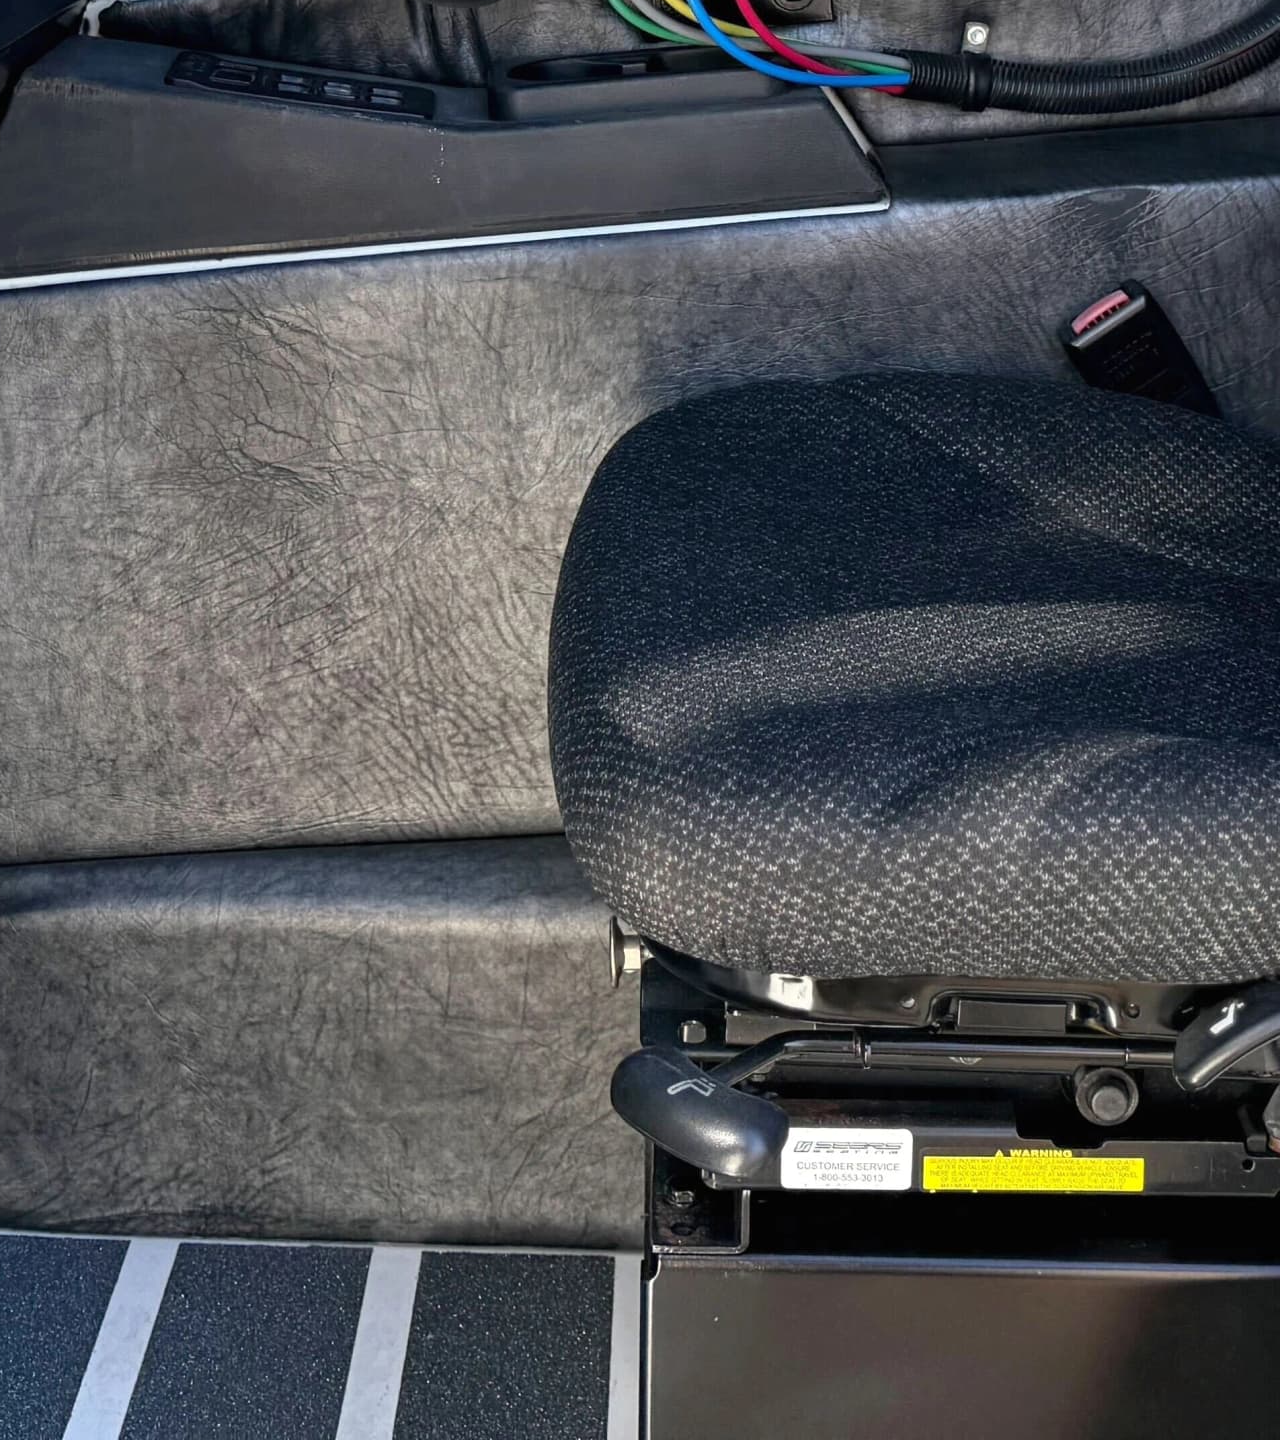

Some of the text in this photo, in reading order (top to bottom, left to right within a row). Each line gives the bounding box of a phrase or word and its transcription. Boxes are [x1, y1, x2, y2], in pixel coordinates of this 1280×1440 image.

[1010, 1149, 1072, 1157] WARNING
[796, 1161, 901, 1171] CUSTOMER SERVICE
[813, 1173, 884, 1182] 1-800-553-3013
